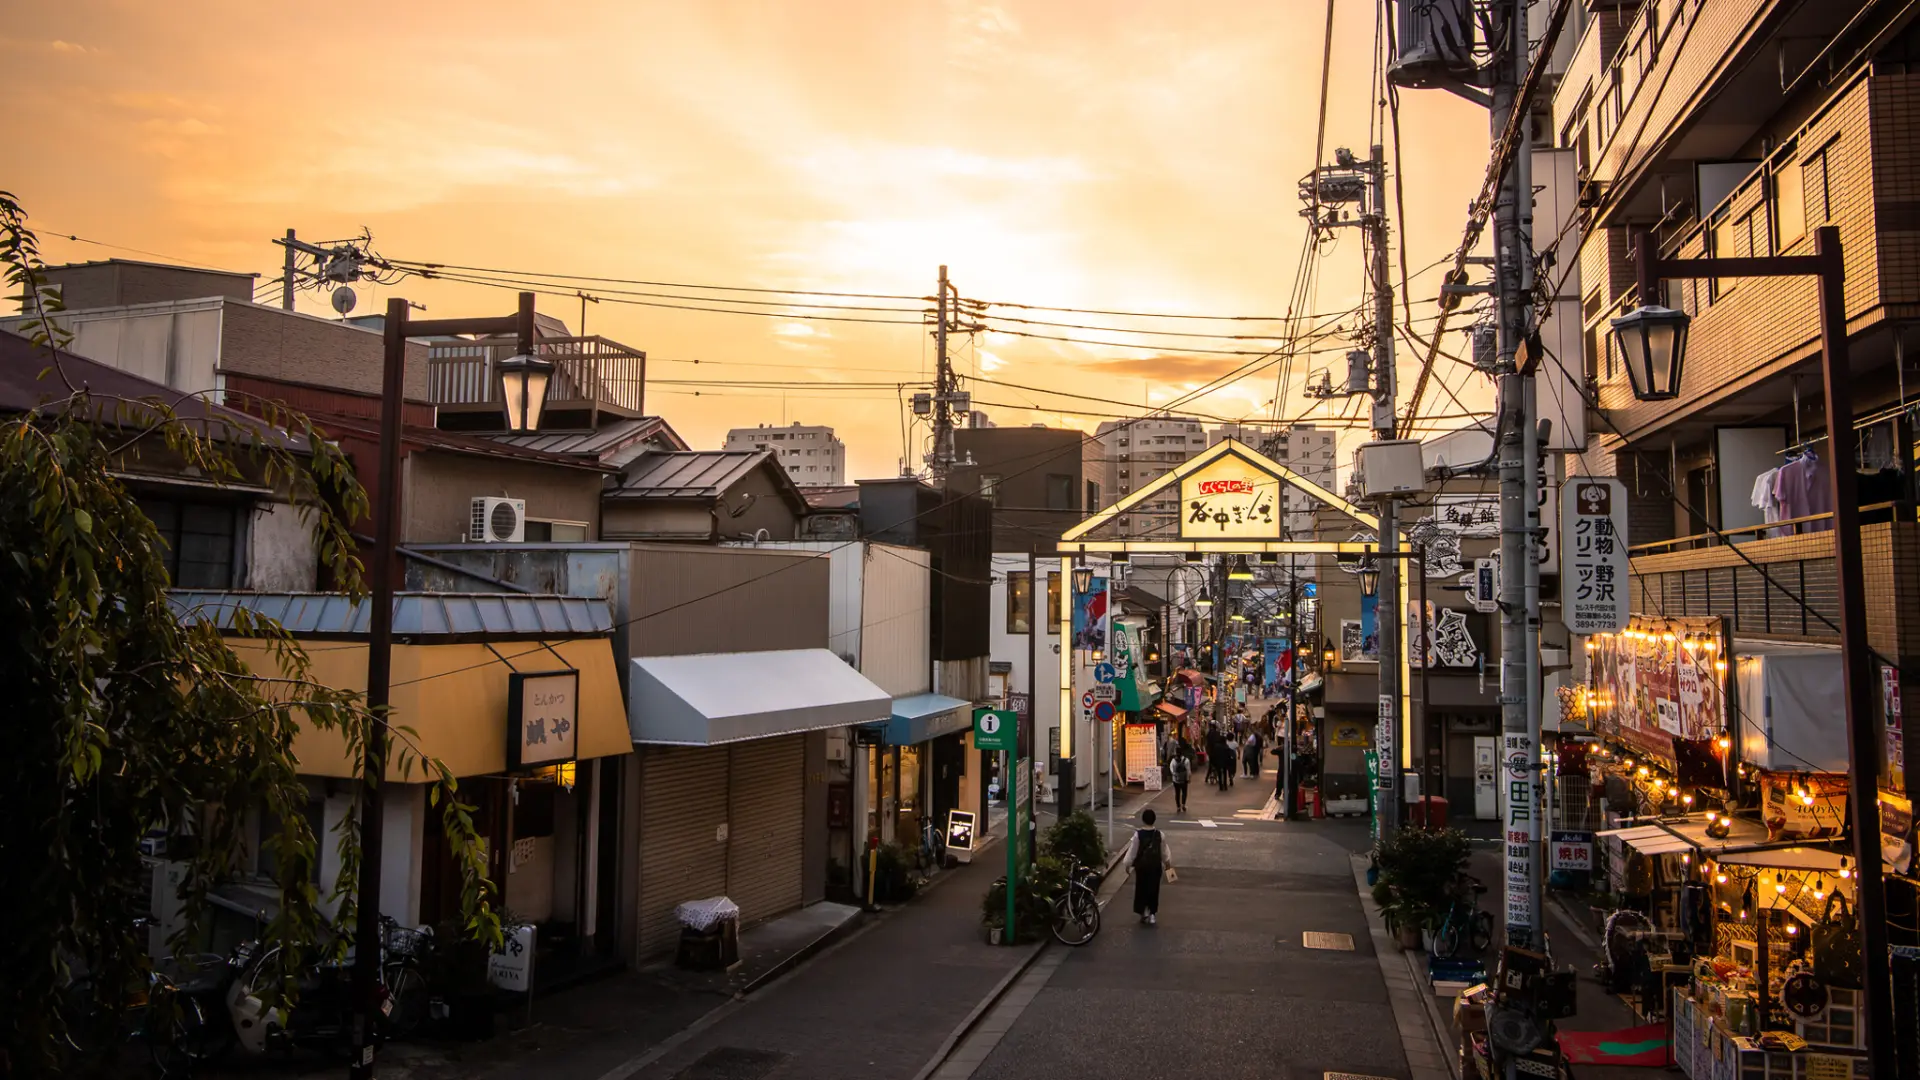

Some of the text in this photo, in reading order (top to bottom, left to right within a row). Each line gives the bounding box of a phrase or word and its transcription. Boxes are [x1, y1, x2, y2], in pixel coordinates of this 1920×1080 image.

[1199, 478, 1253, 494] ひぐらしの里
[1188, 490, 1273, 532] 谷中ぎんざ
[1575, 518, 1593, 600] クリニック
[1594, 517, 1615, 602] 動物・野沢
[533, 693, 565, 706] とんかつ
[1561, 833, 1583, 841] Asahi
[1558, 846, 1588, 861] 焼肉
